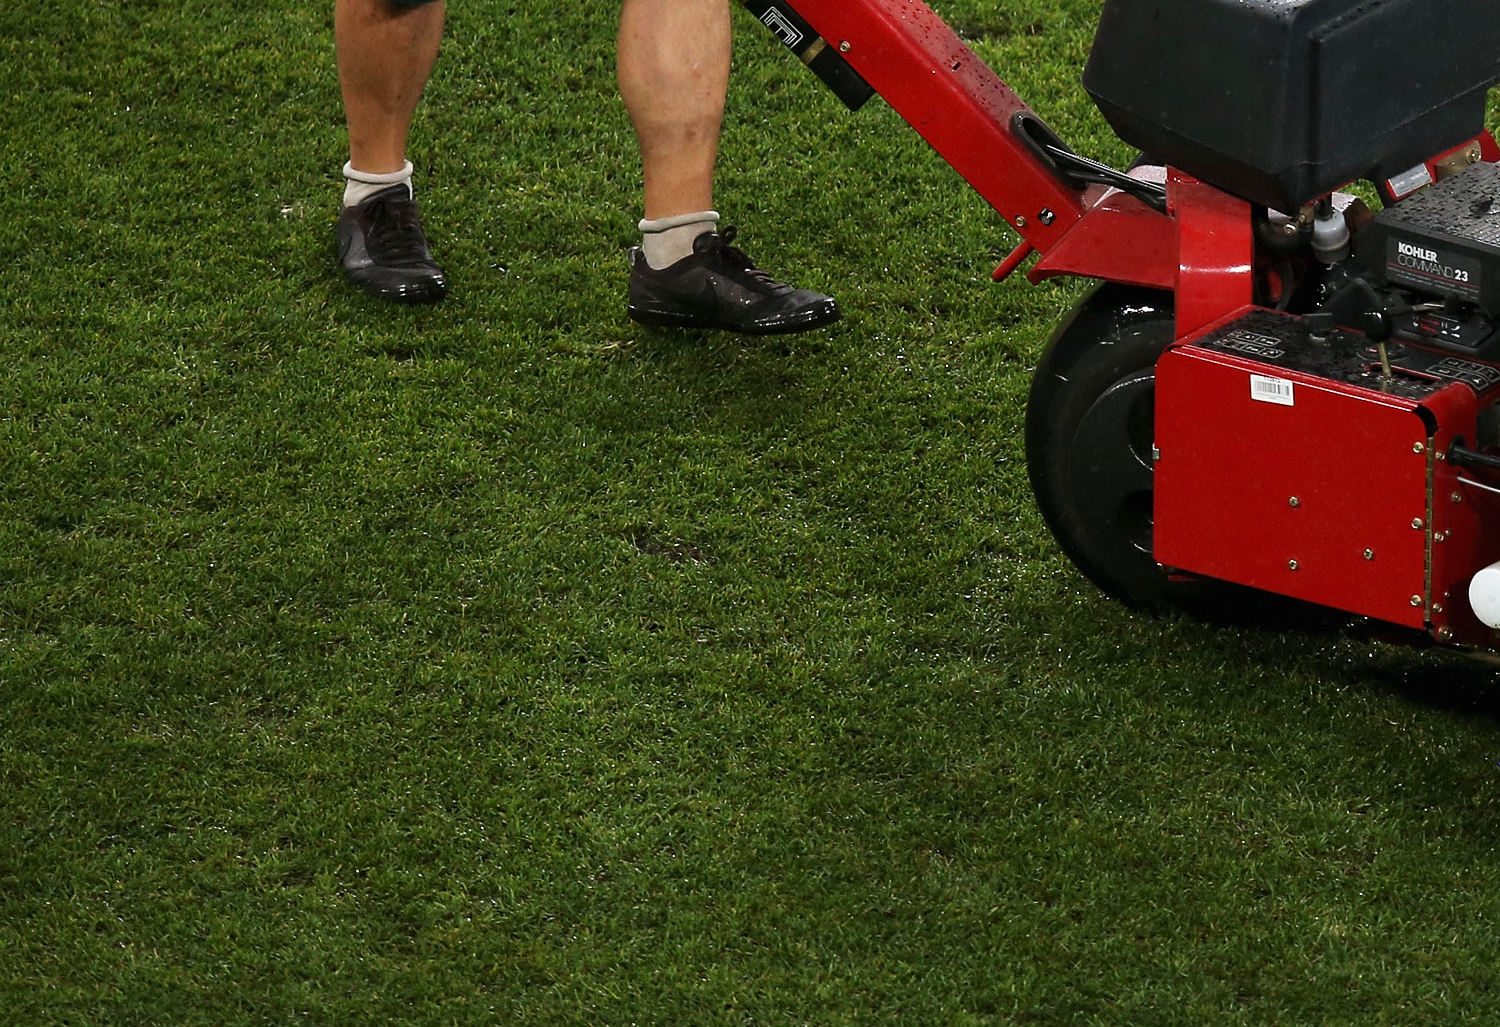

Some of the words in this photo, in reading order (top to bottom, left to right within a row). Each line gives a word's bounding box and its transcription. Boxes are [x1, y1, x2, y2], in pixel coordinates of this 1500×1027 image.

[1398, 241, 1438, 263] KOHLER
[1397, 254, 1453, 278] COMMAND
[1454, 269, 1469, 282] 23
